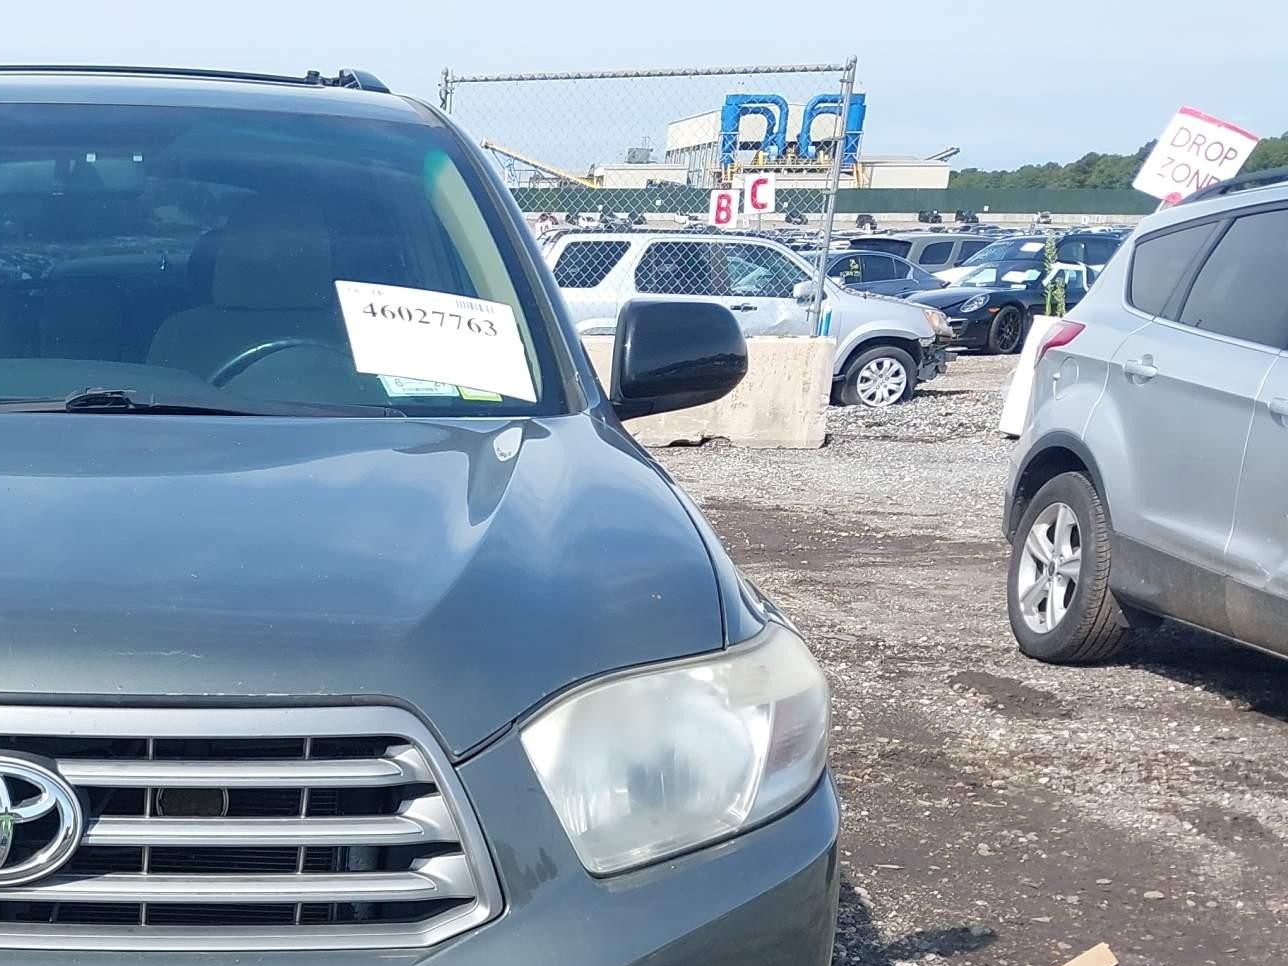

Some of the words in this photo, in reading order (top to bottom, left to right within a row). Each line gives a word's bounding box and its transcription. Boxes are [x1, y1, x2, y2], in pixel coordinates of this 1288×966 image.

[1170, 126, 1239, 167] DROP
[714, 193, 732, 225] B
[750, 178, 768, 210] C
[362, 302, 498, 337] 46027763
